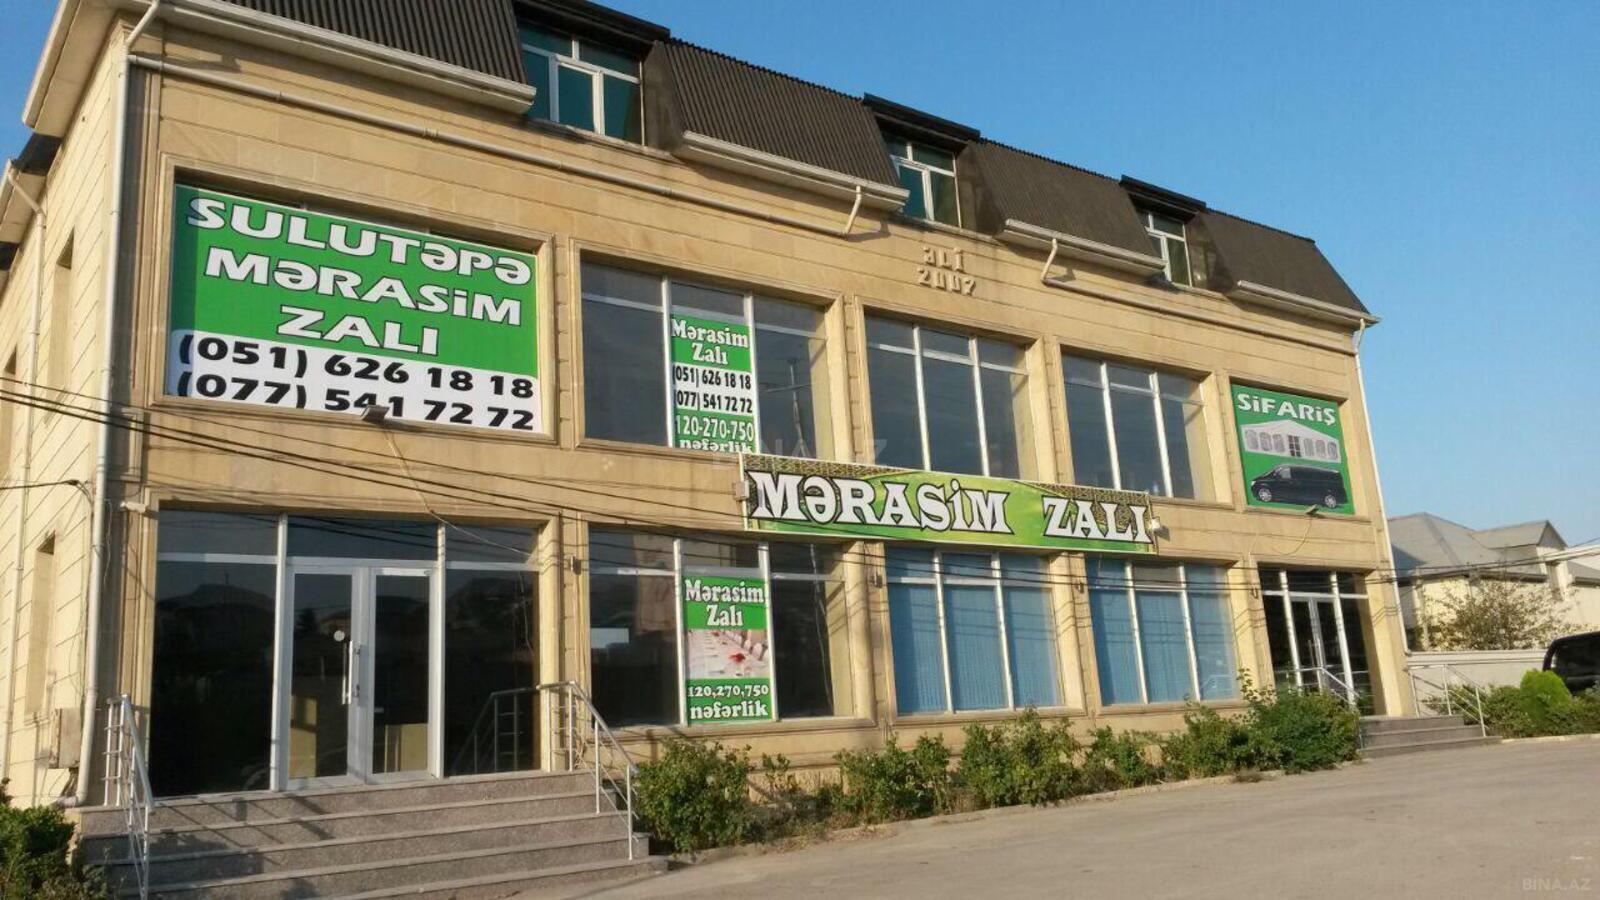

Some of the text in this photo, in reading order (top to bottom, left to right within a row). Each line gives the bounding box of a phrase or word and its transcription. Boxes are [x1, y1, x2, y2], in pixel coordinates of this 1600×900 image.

[917, 268, 976, 297] 2007
[276, 304, 440, 356] ZALI
[671, 318, 749, 348] Mərasim
[179, 334, 534, 399] (051) 626 18 18
[702, 369, 721, 386] 626
[725, 372, 737, 388] 18
[740, 374, 751, 390] 18
[177, 371, 534, 431] (077) 541 72 72
[703, 393, 722, 410] 541
[724, 396, 738, 412] 72
[740, 398, 753, 413] 72
[1041, 494, 1154, 545] ZALI
[685, 579, 765, 603] Mərasim
[690, 700, 768, 720] nəfərlik
